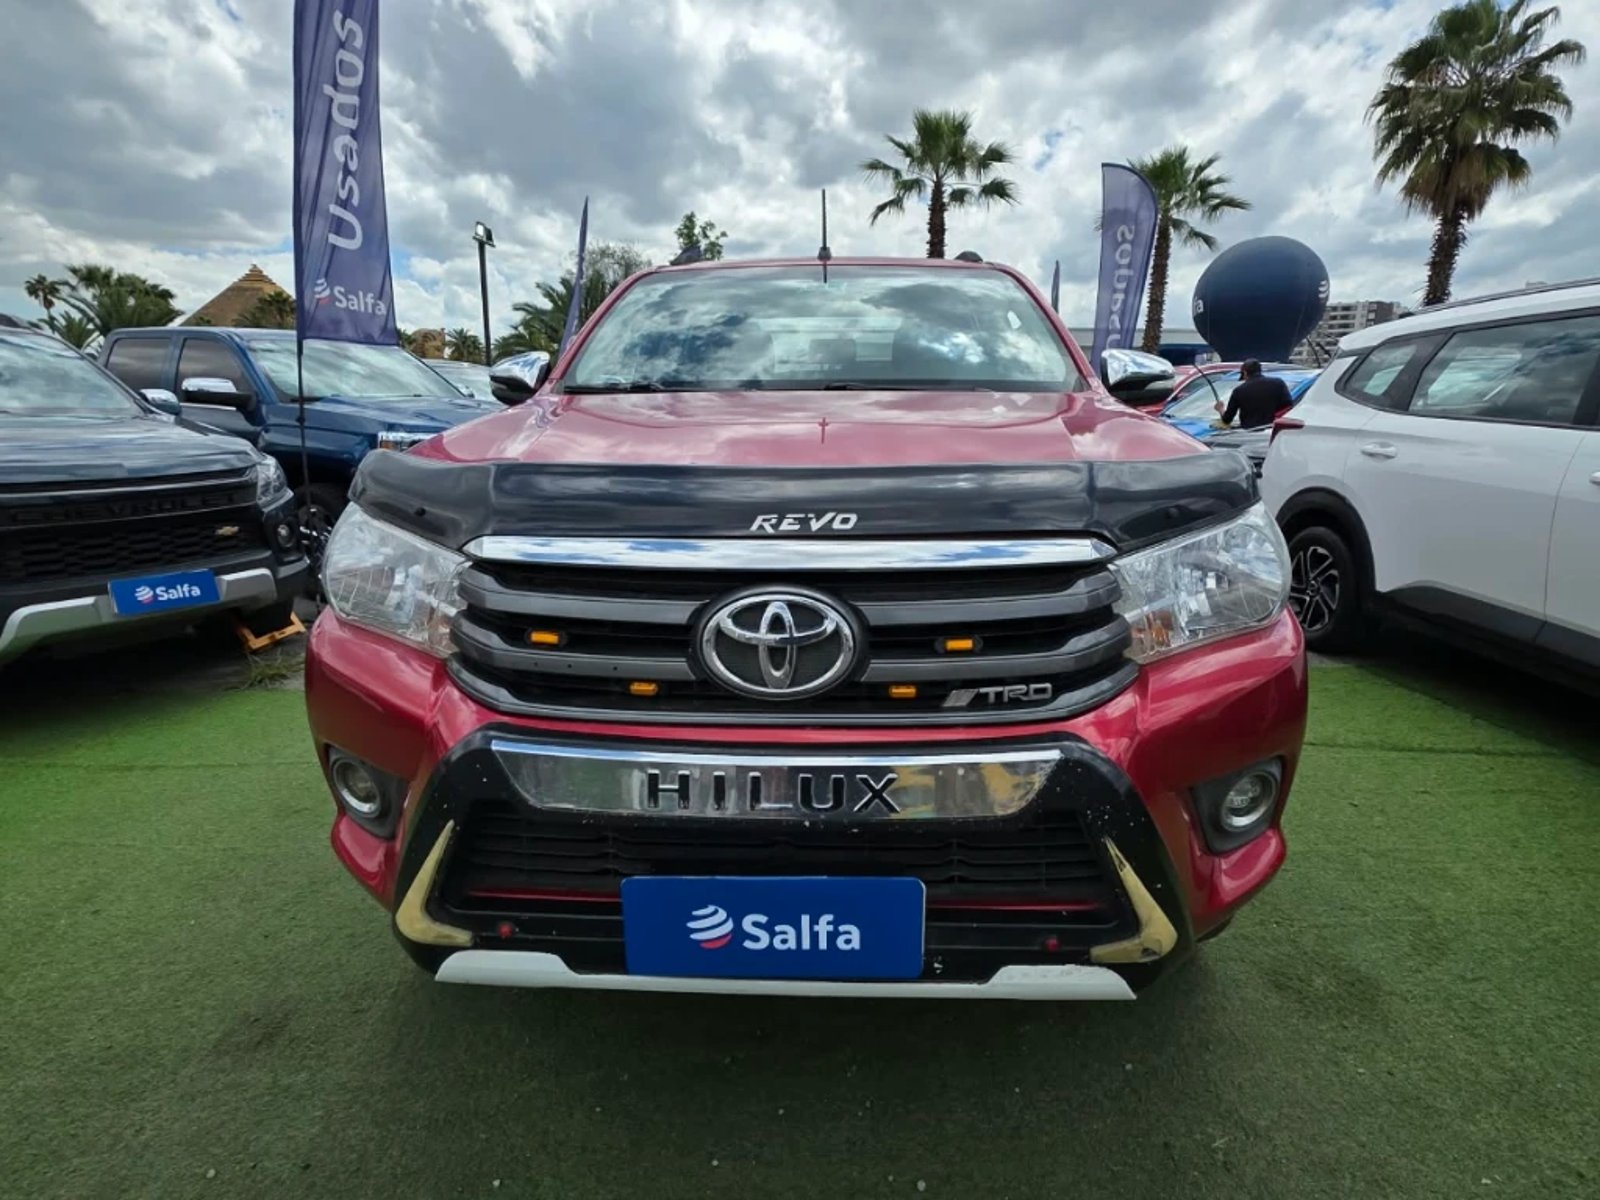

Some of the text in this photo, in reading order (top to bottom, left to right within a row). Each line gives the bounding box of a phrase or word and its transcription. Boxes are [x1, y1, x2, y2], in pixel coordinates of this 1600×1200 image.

[323, 9, 364, 250] Usados
[333, 286, 387, 317] Salfa
[749, 511, 858, 534] REVO
[155, 583, 201, 601] Salfa
[979, 683, 1053, 704] TRD
[647, 769, 901, 814] HILUX
[741, 913, 861, 951] Salfa
